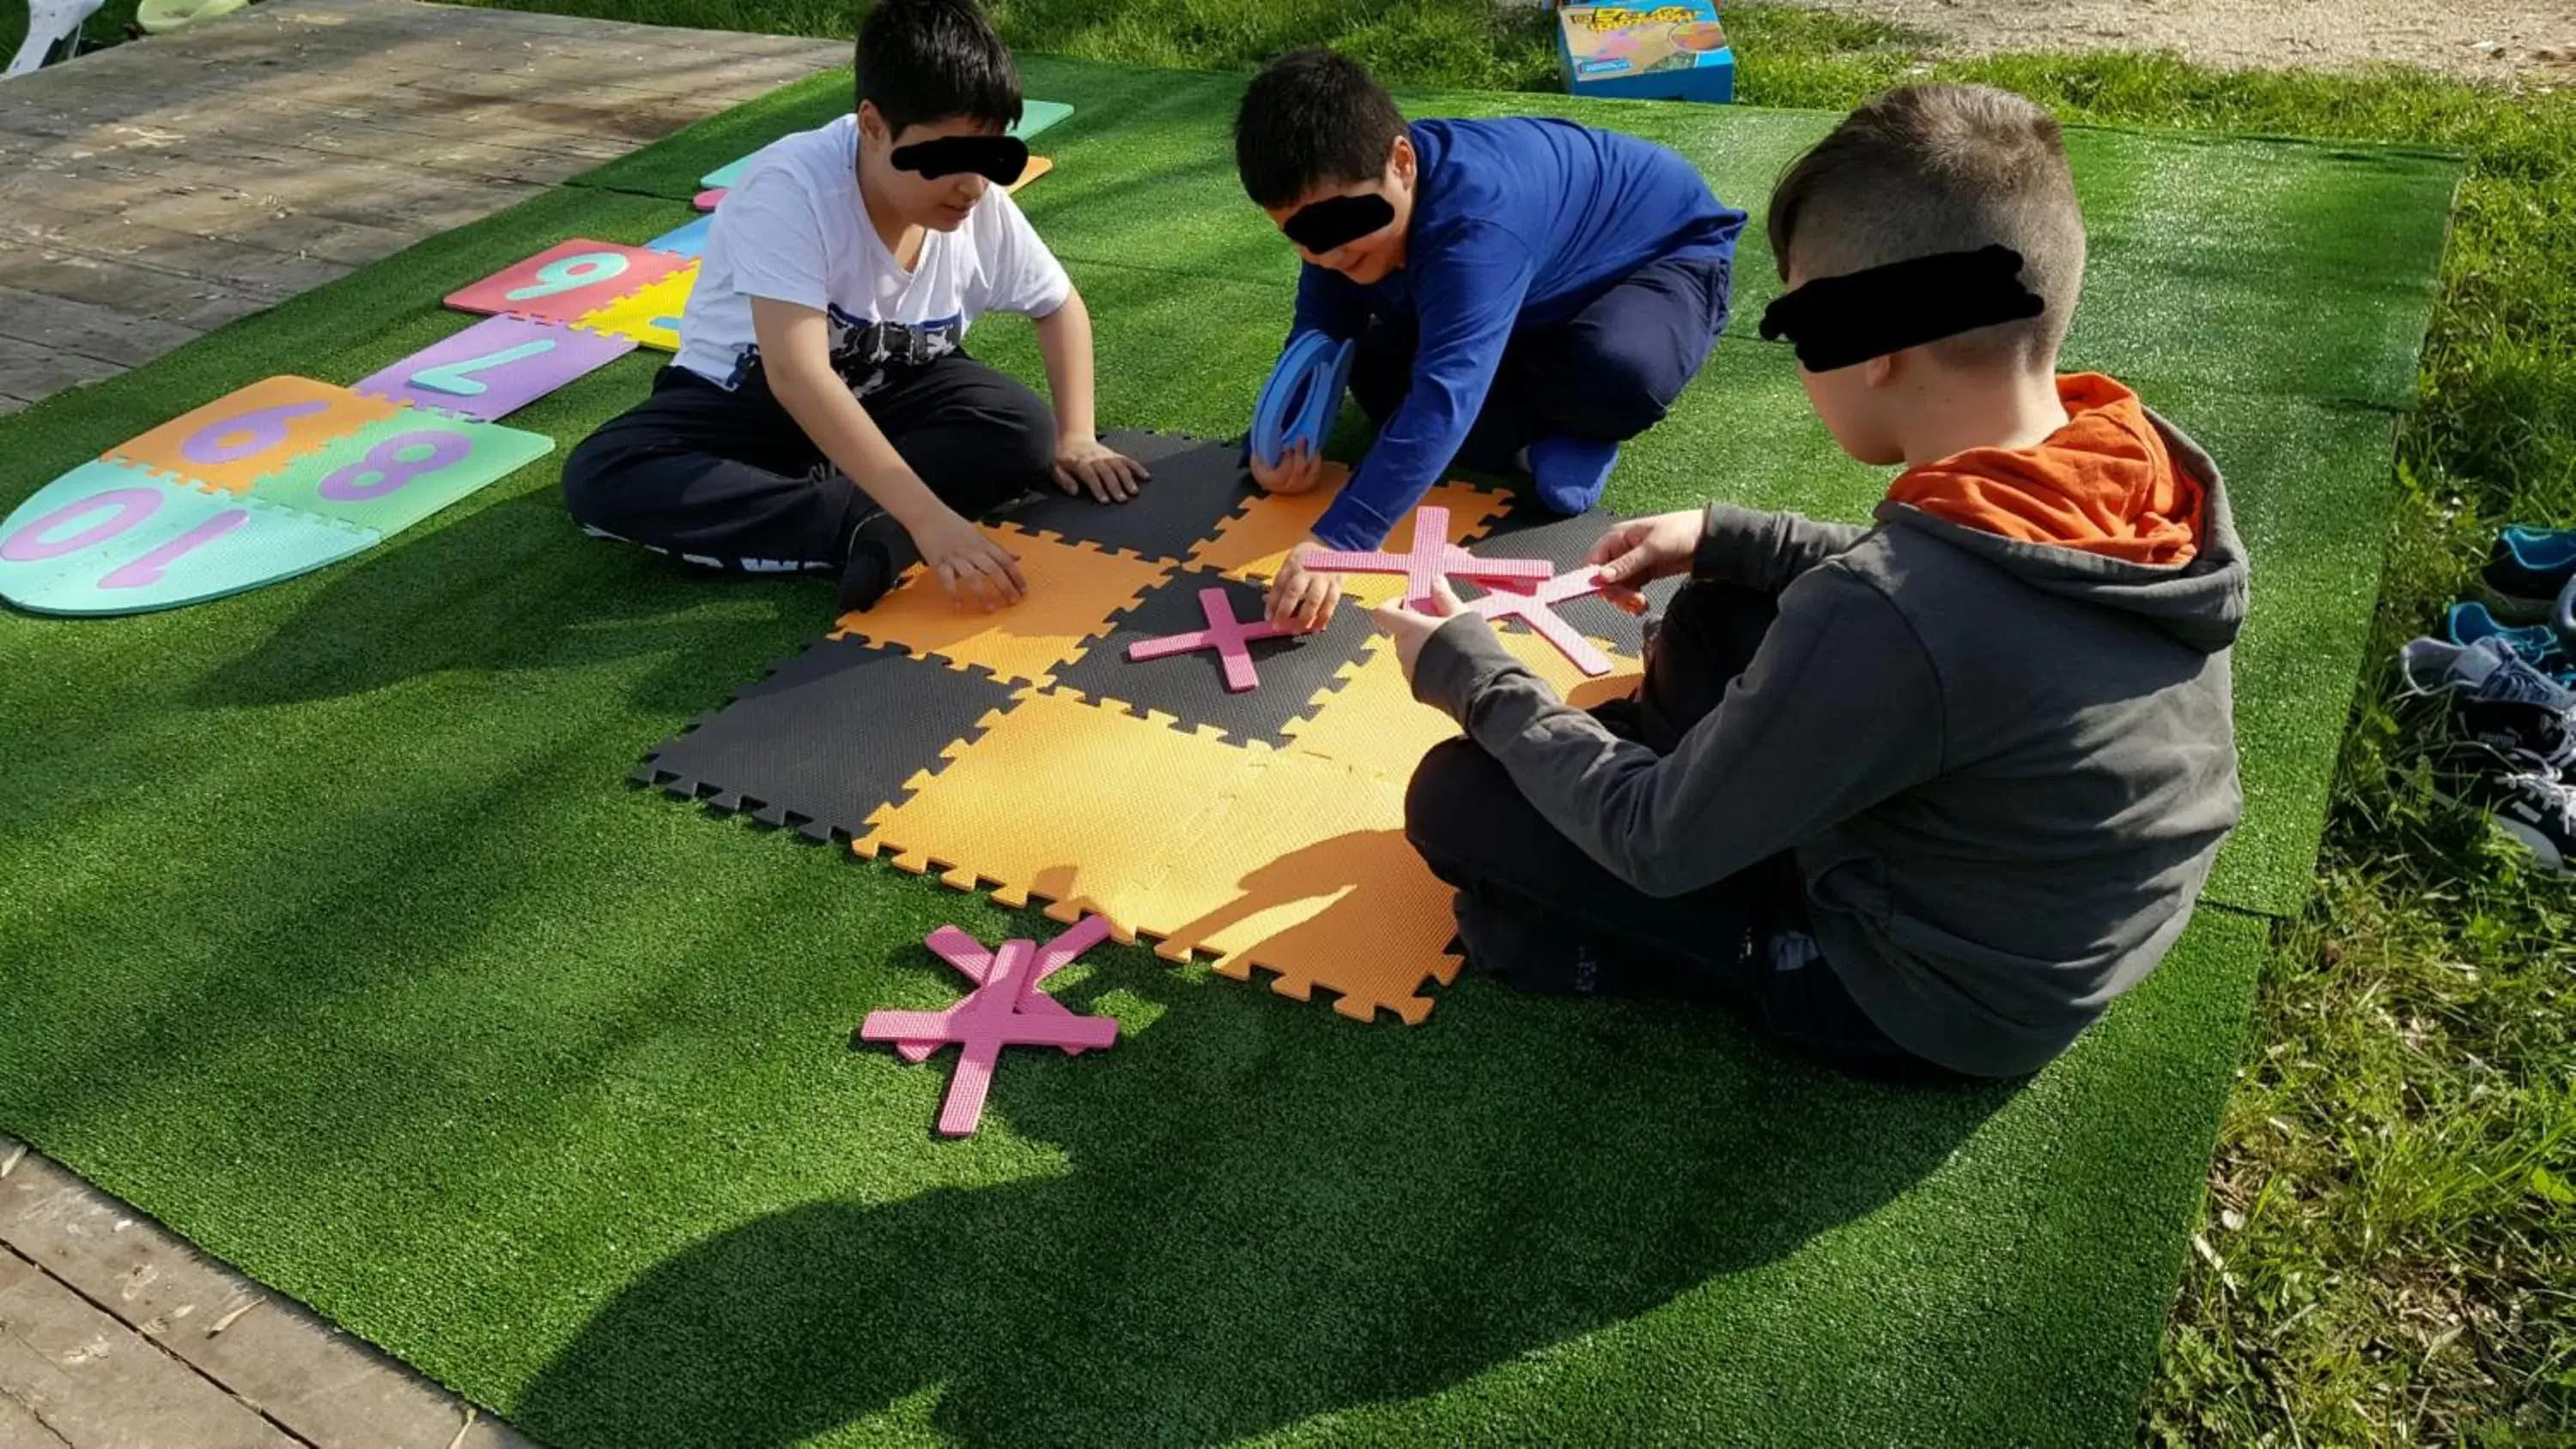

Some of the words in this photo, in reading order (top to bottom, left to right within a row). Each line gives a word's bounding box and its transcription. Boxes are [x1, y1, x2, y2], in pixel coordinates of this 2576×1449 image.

[409, 339, 555, 397] 7
[318, 431, 473, 500] 8
[1, 488, 248, 589] 10
